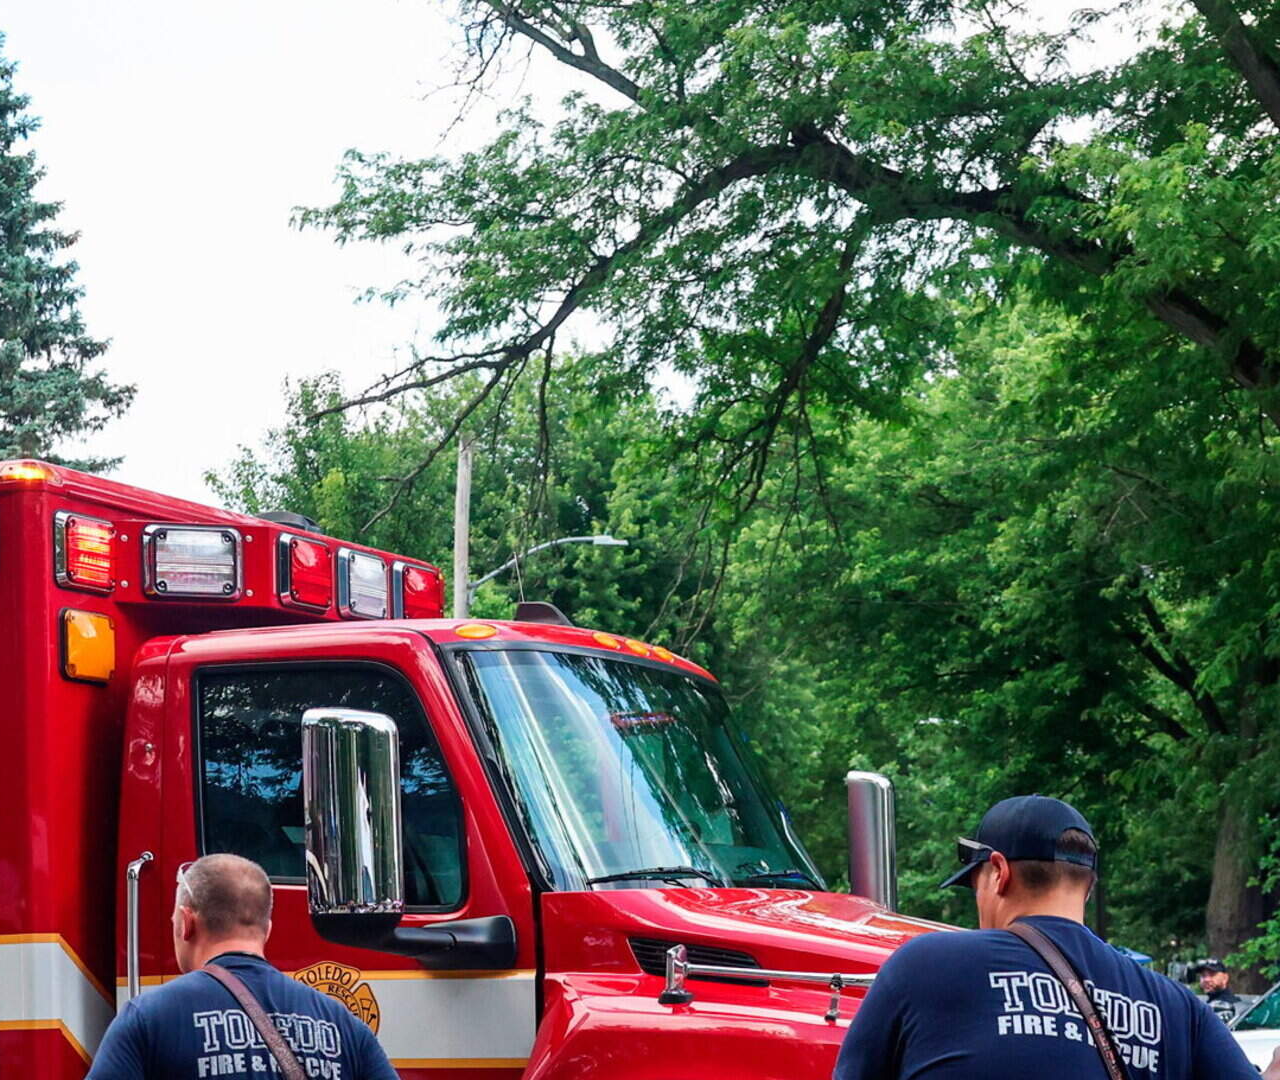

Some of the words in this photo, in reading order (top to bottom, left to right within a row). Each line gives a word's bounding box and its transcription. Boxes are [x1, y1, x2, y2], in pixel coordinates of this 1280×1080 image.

[298, 964, 353, 986] TOLEDO
[997, 1014, 1059, 1036] FIRE
[1064, 1021, 1083, 1042] &
[197, 1053, 248, 1078] FIRE
[251, 1055, 267, 1073] &
